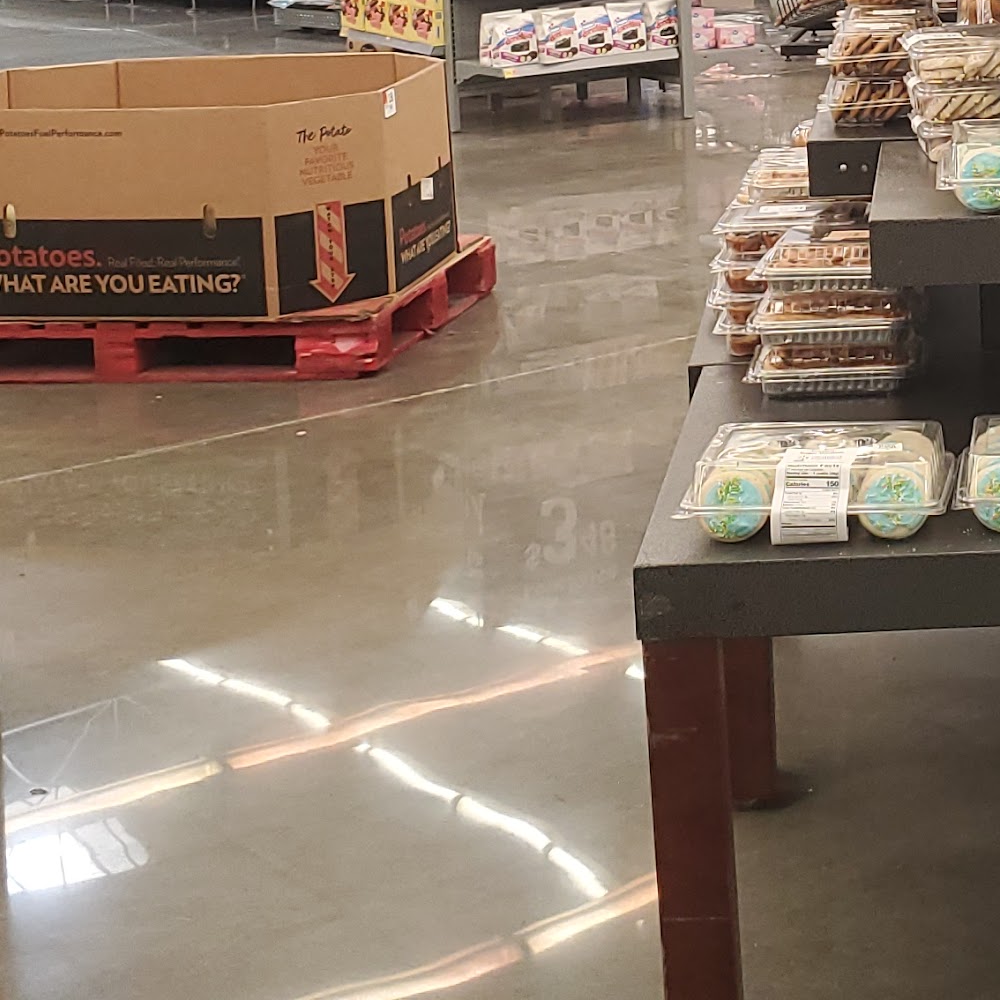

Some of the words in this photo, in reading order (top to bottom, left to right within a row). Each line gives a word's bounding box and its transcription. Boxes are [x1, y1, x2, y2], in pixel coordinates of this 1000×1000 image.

[296, 127, 317, 144] The
[319, 124, 353, 142] Potato
[0, 273, 47, 294] HAT
[50, 273, 93, 294] ARE
[93, 273, 145, 294] YOU
[146, 273, 242, 294] EATING?
